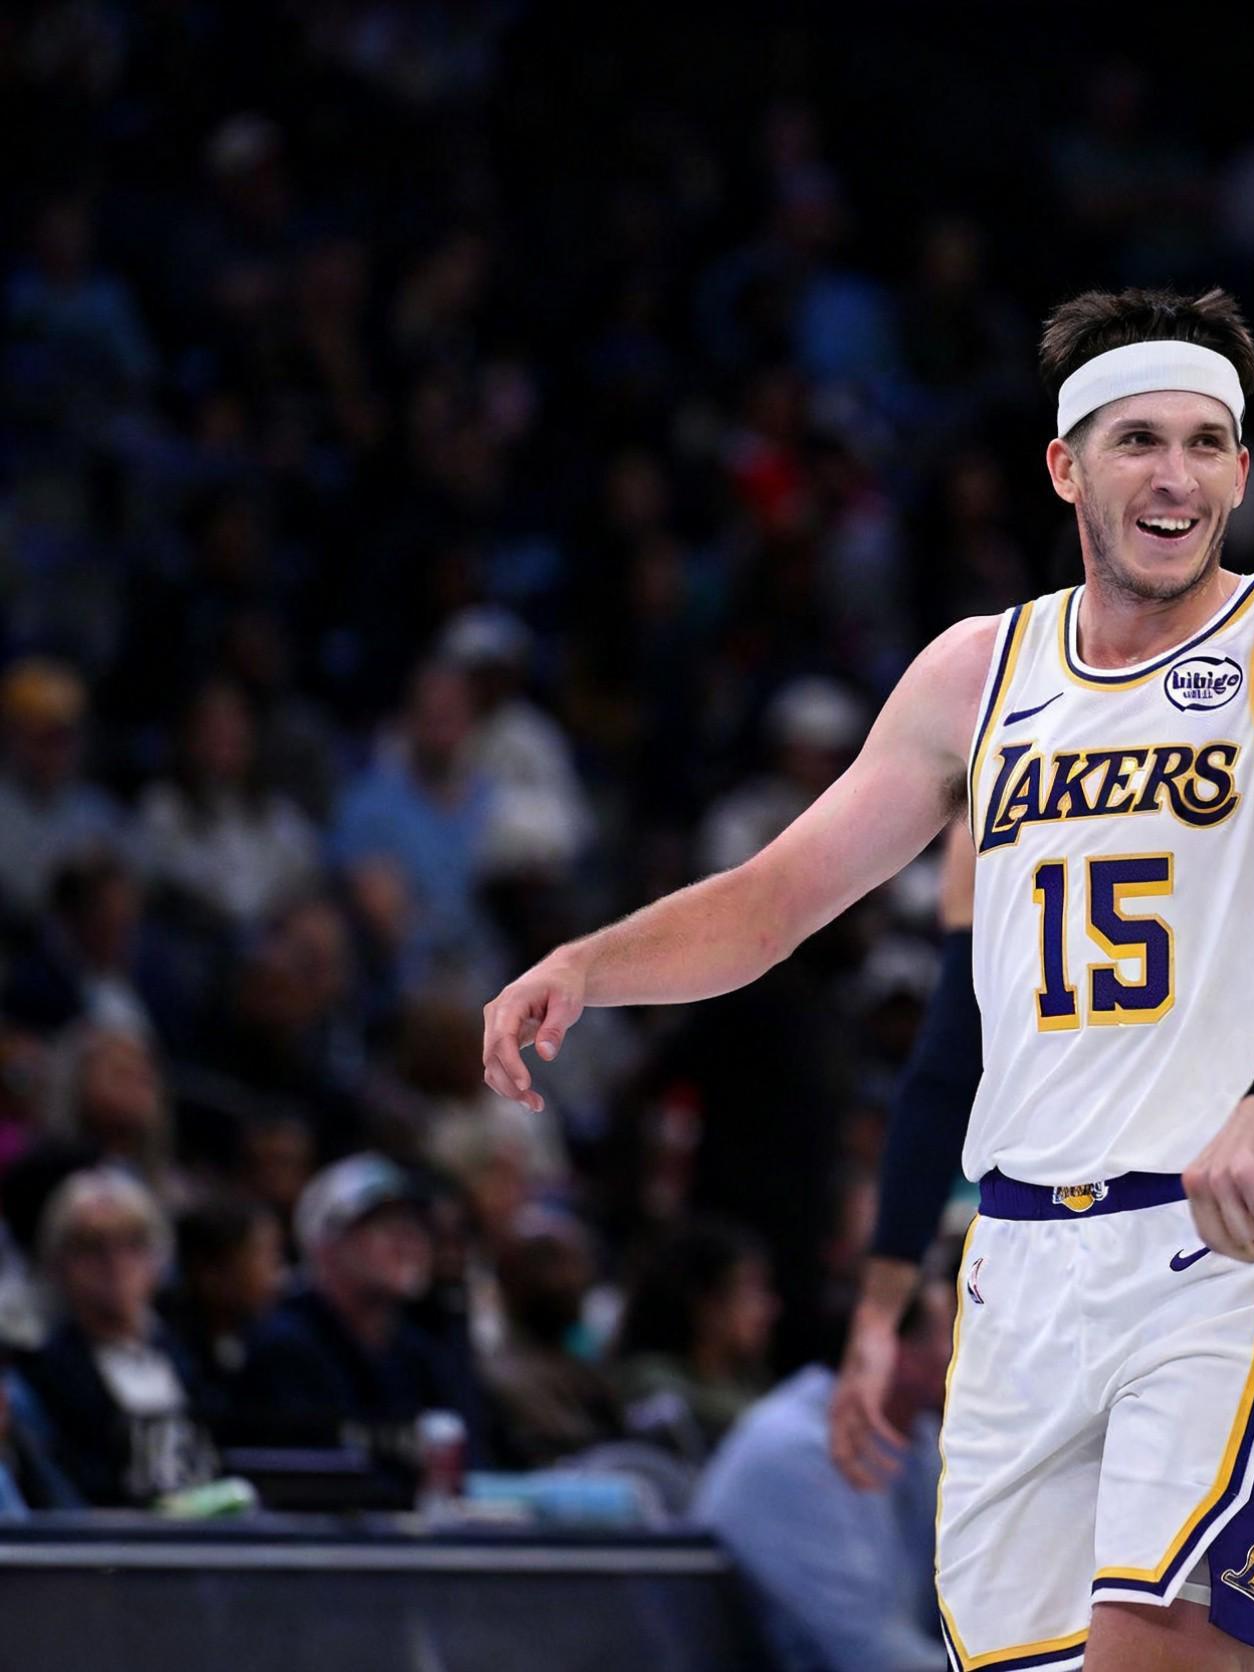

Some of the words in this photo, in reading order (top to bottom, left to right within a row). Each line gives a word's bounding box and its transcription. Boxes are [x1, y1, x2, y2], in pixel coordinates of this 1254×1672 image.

[1172, 670, 1240, 695] bibigo
[979, 740, 1242, 855] LAKERS
[1032, 852, 1175, 1032] 15
